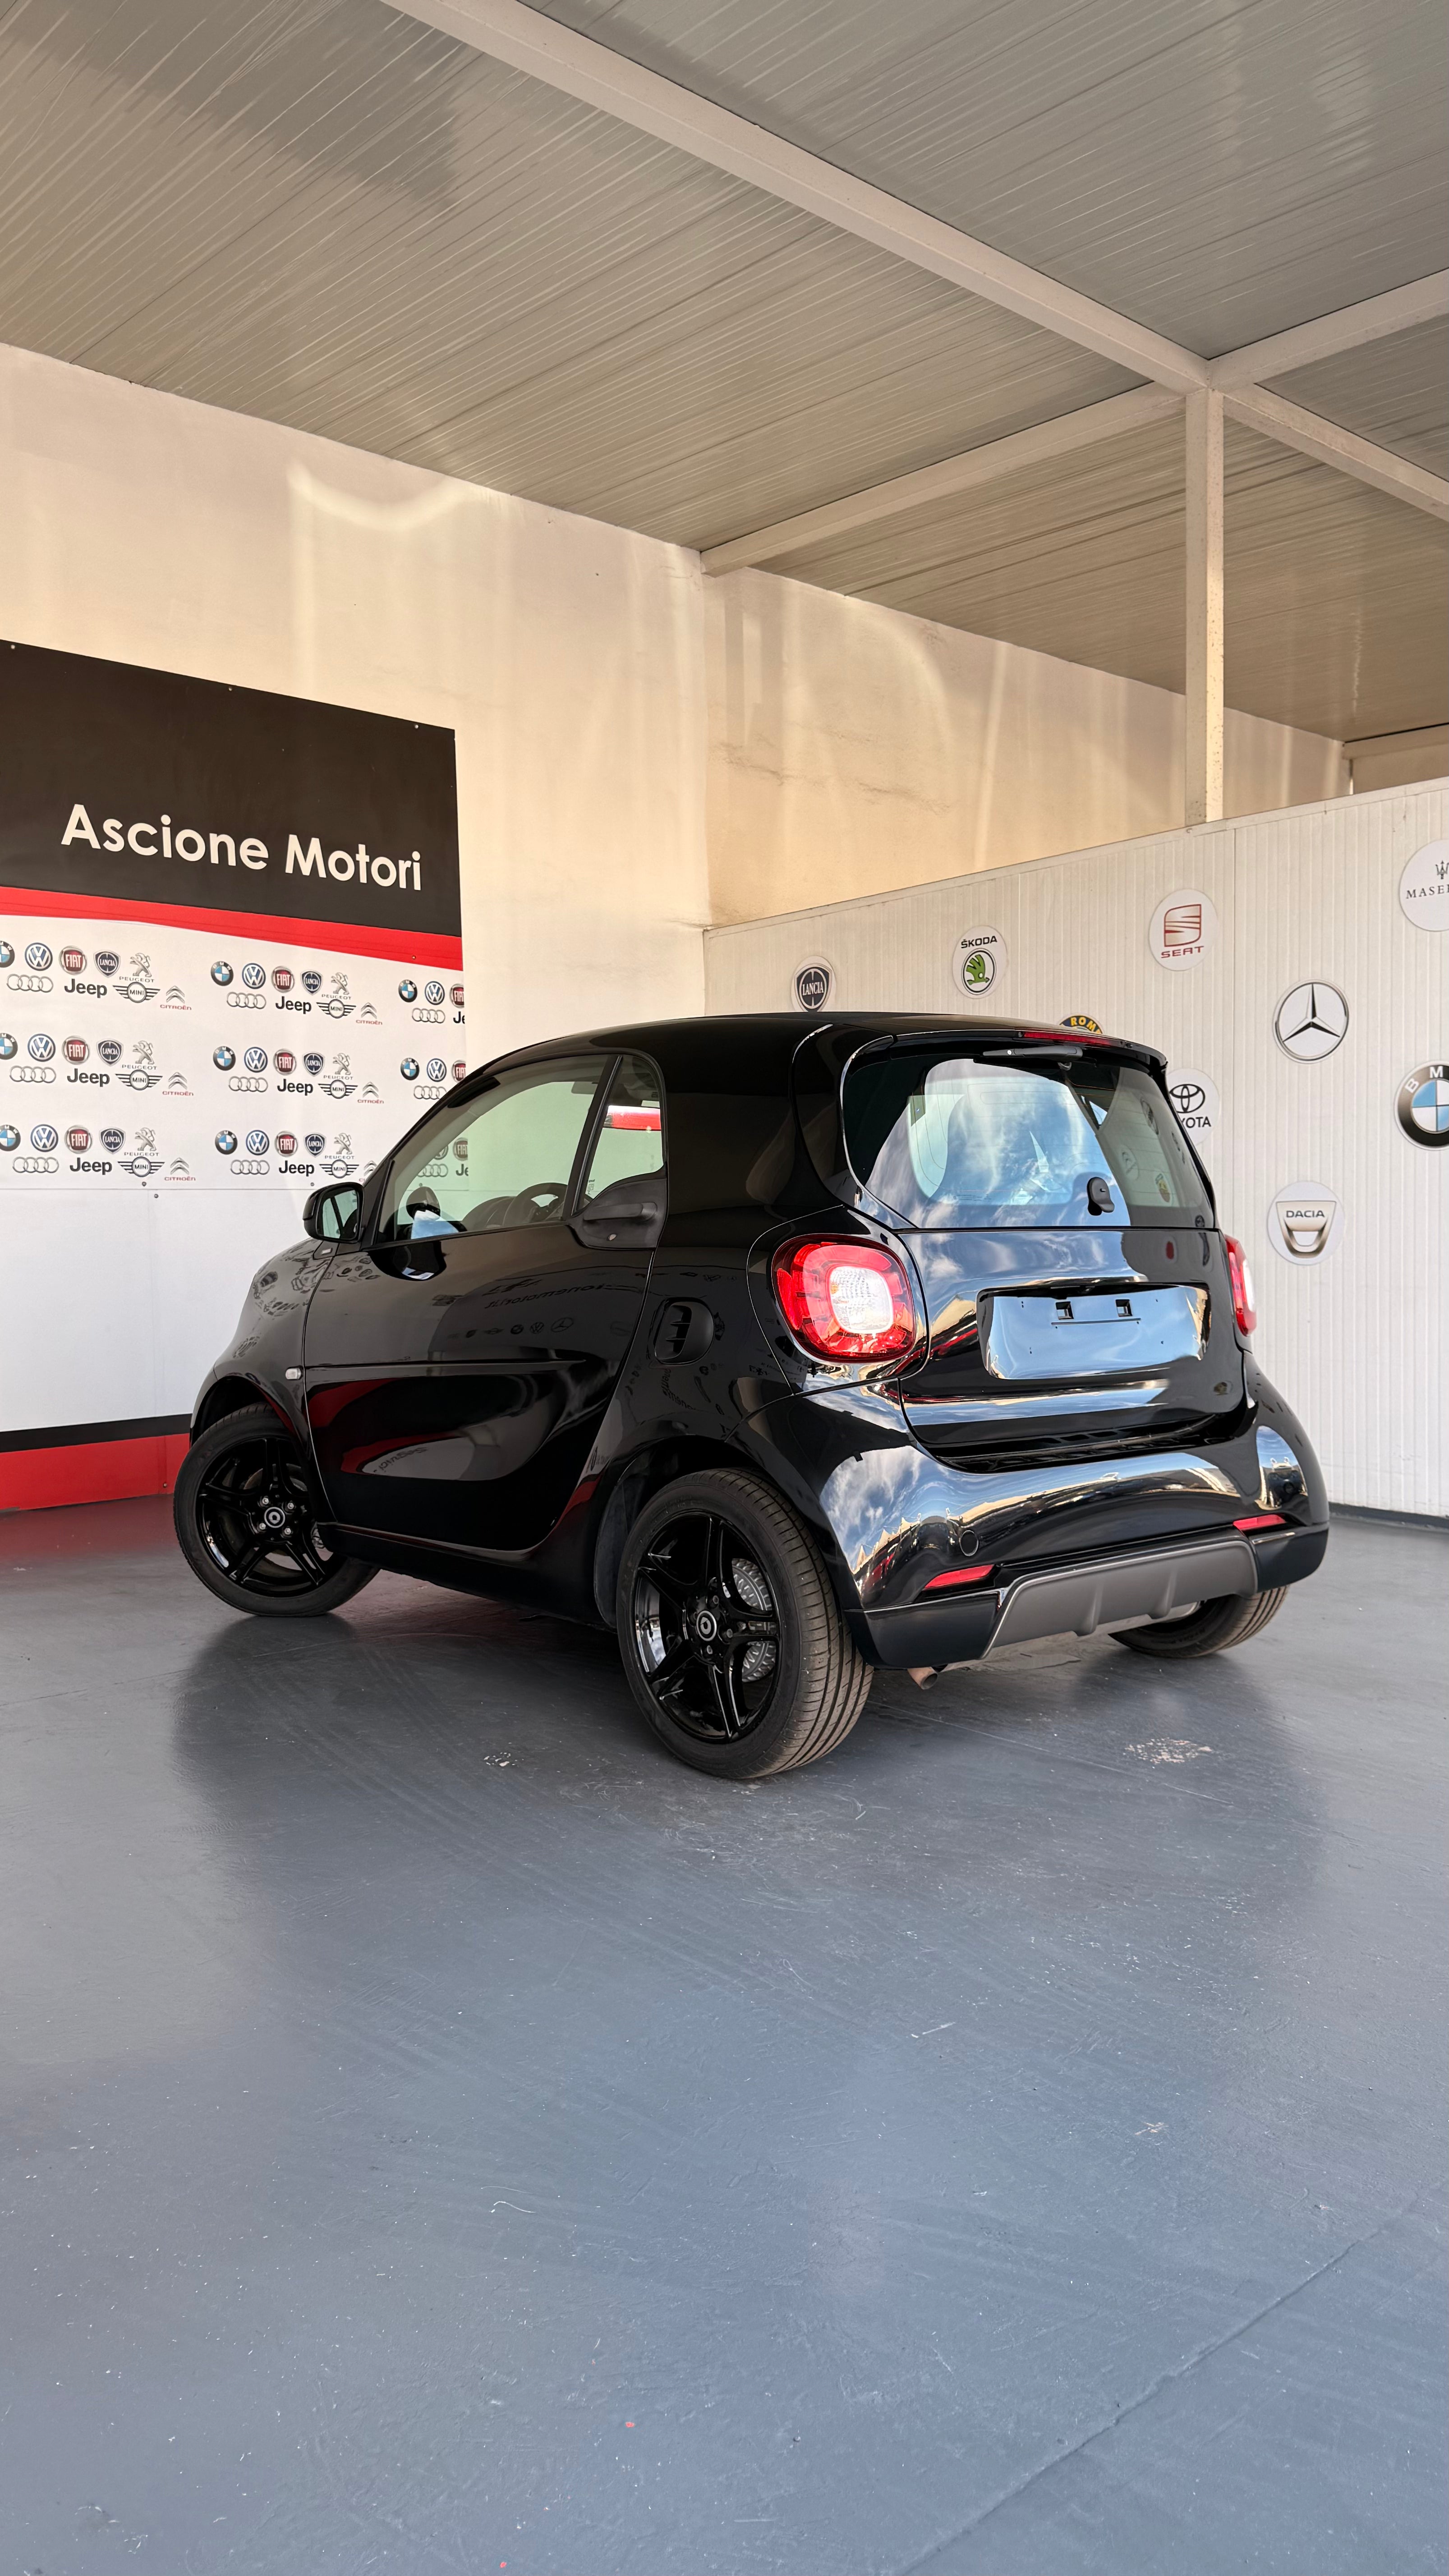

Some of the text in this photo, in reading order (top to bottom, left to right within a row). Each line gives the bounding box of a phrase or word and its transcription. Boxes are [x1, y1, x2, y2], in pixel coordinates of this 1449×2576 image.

[61, 804, 421, 891] Ascione Motori
[1406, 884, 1449, 899] MASE
[961, 935, 997, 948] ŠKODA
[1161, 946, 1204, 958] SEAT
[66, 954, 82, 968] FIAT
[276, 974, 291, 986] FIAT
[64, 979, 107, 998] Jeep
[802, 983, 824, 996] LANCIA
[454, 990, 464, 1002] FIA
[276, 996, 312, 1014] Jeep
[69, 1044, 84, 1058] FIAT
[279, 1057, 292, 1068] FIAT
[67, 1068, 110, 1087] Jeep
[455, 1067, 465, 1078] FIA
[1405, 1066, 1443, 1093] BM
[277, 1079, 313, 1096] Jeep
[1182, 1116, 1211, 1128] OTA
[71, 1134, 87, 1146] FIAT
[280, 1139, 294, 1150] FIAT
[70, 1158, 112, 1175] Jeep
[279, 1160, 314, 1177] Jeep
[1286, 1210, 1325, 1218] DACIA
